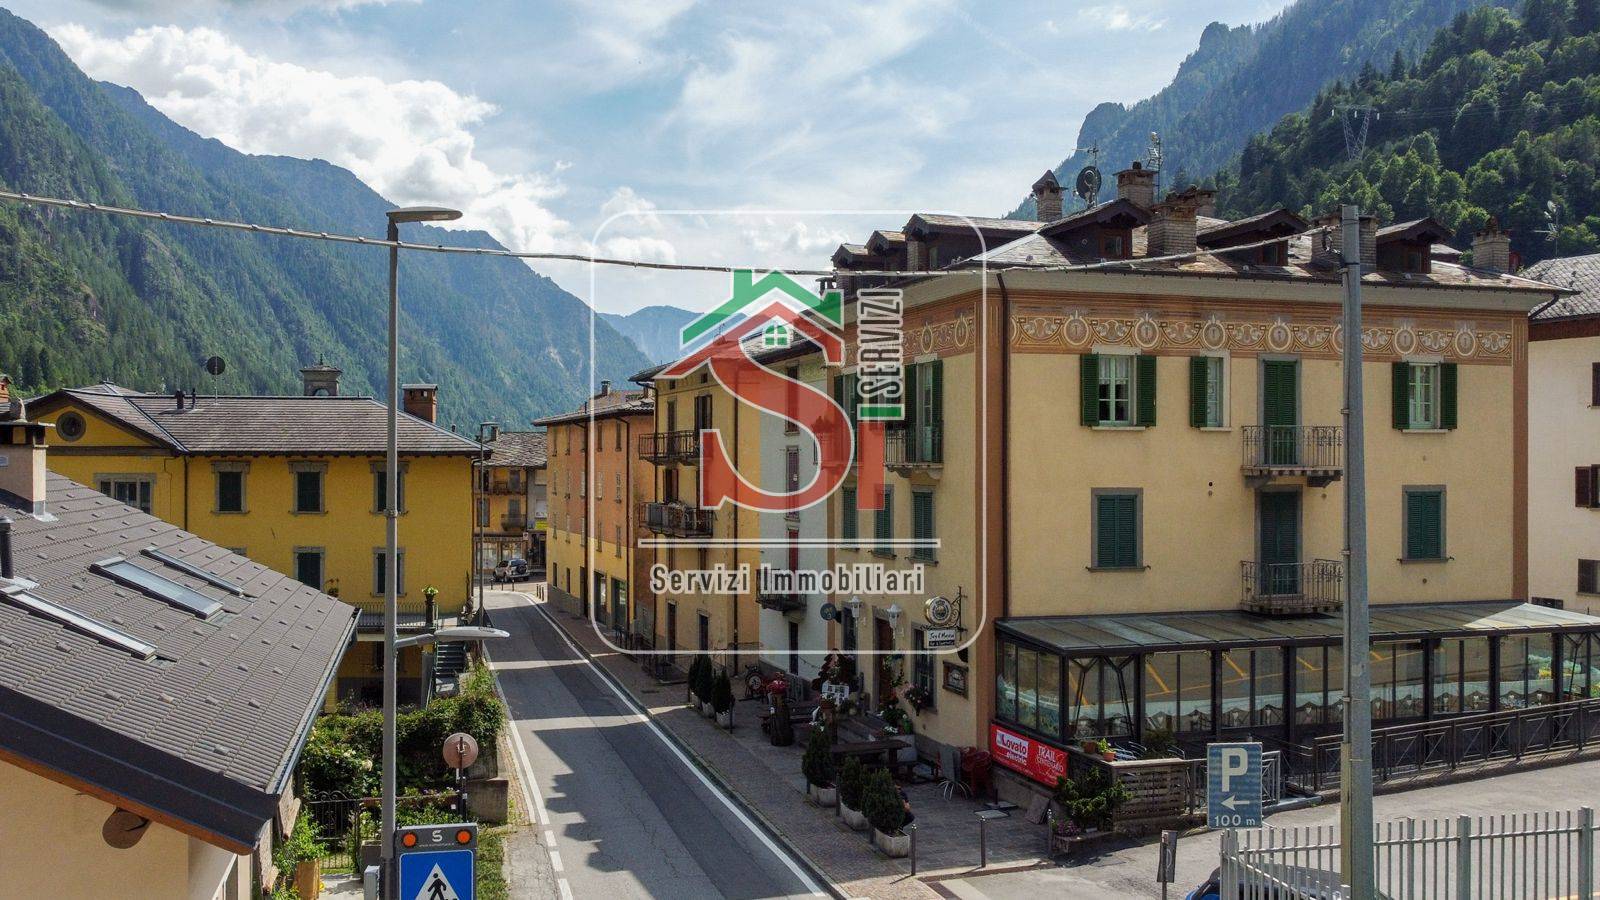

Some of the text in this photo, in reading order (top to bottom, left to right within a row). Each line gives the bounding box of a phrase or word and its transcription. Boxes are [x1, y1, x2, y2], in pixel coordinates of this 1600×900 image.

[1221, 747, 1248, 792] P
[1214, 814, 1256, 827] 100 m
